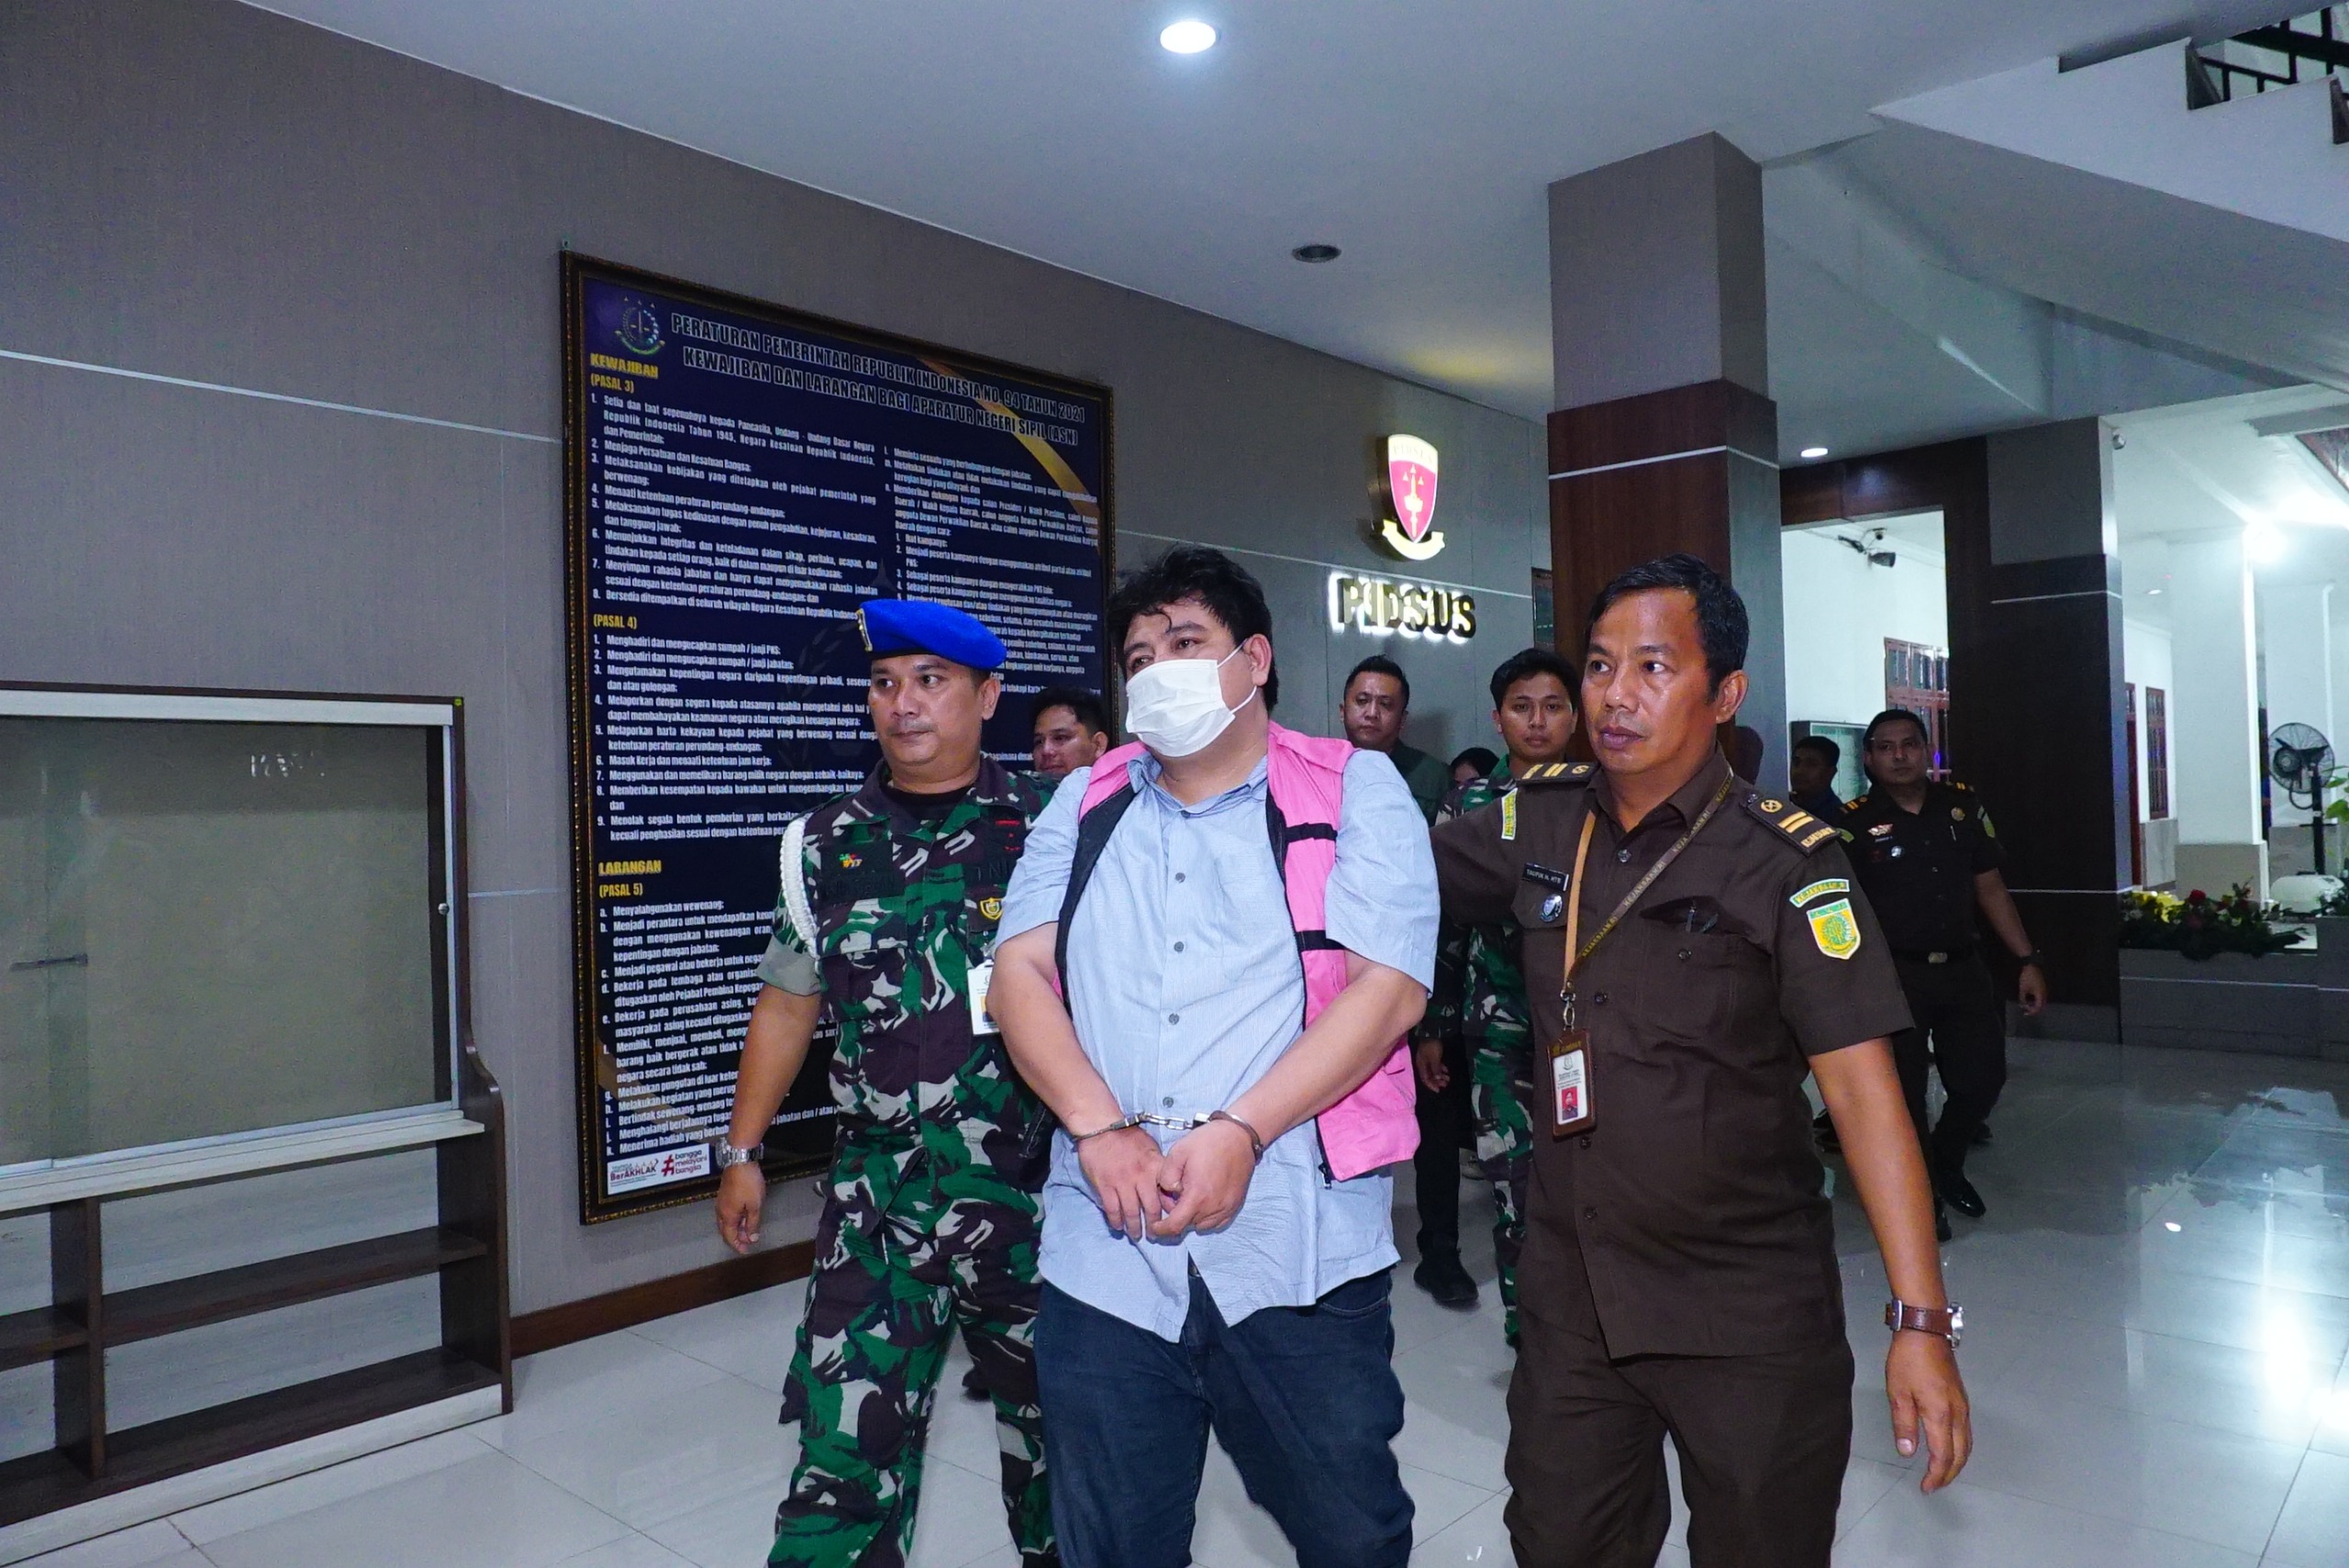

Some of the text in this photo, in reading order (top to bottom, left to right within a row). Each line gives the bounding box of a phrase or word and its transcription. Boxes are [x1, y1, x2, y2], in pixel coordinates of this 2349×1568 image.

[590, 353, 659, 379] KEWAJIBAN
[671, 313, 1085, 423] PERATURAN PEMERINTAH REPUBLIK INDONESIA NO. 94 TAHUN 2021
[591, 374, 634, 394] (PASAL 3)
[683, 346, 1078, 446] KEWAJIBAN DAN LARANGAN BAGI APARATUR NEGERI SIPIL (ASN)
[604, 395, 735, 430] Setia dan taat kepada
[604, 410, 837, 462] Republik Indonesia Tahun Negara Kesatuan Republik
[604, 439, 723, 470] Menjaga Persatuan dan Kesatuan
[605, 454, 876, 507] Melaksanakan kebijakan yang ditetapkan oleh pejabat pemerintah yang
[605, 484, 710, 510] Menaati ketentuan peraturan
[605, 499, 720, 524] Melaksanakan tugas kedinasan
[605, 515, 656, 532] dan tanggung
[605, 529, 783, 560] Menunjukkan integritas dan keteladanan dalam
[605, 544, 759, 571] tindakan kepada setiap baik di dalam
[606, 560, 728, 581] Menyimpan rahasia jabatan dan
[606, 590, 722, 609] Bersedia ditempatkan di seluruh
[1336, 578, 1475, 639] PIDSUS
[594, 614, 637, 629] (PASAL 4)
[607, 635, 766, 655] Menghadiri dan mengucapkan sumpah janji
[607, 665, 774, 684] Mengutamakan kepentingan negara daripada
[607, 695, 738, 710] Melaporkan dengan segera kepada
[607, 725, 794, 740] Melaporkan harta kekayaan kepada pejabat yang
[609, 756, 656, 767] Masuk Kerja
[609, 770, 747, 782] Menggunakan dan memelihara barang
[609, 784, 766, 796] Memberikan kesempatan kepada bawahan
[610, 813, 764, 826] Menolak segala bentuk yang
[610, 828, 685, 841] kecuali penghasilan
[598, 860, 662, 876] LARANGAN
[599, 883, 643, 898] (PASAL 5)
[613, 903, 683, 918] Menyalahgunakan
[613, 915, 706, 932] Menjadi perantara untuk
[613, 927, 751, 947] dengan menggunakan kewenangan
[614, 955, 744, 978] Menjadi pegawai atau bekerja untuk
[613, 972, 724, 994] Bekerja pada lembaga atau
[615, 988, 703, 1008] ditugaskan oleh Pejabat
[615, 1001, 718, 1024] Bekerja pada perusahaan
[616, 1022, 661, 1039] masyarakat
[617, 1044, 718, 1069] barang baik bergerak atau
[618, 1082, 660, 1097] Melakukan
[610, 1166, 656, 1181] BerAKHLAK
